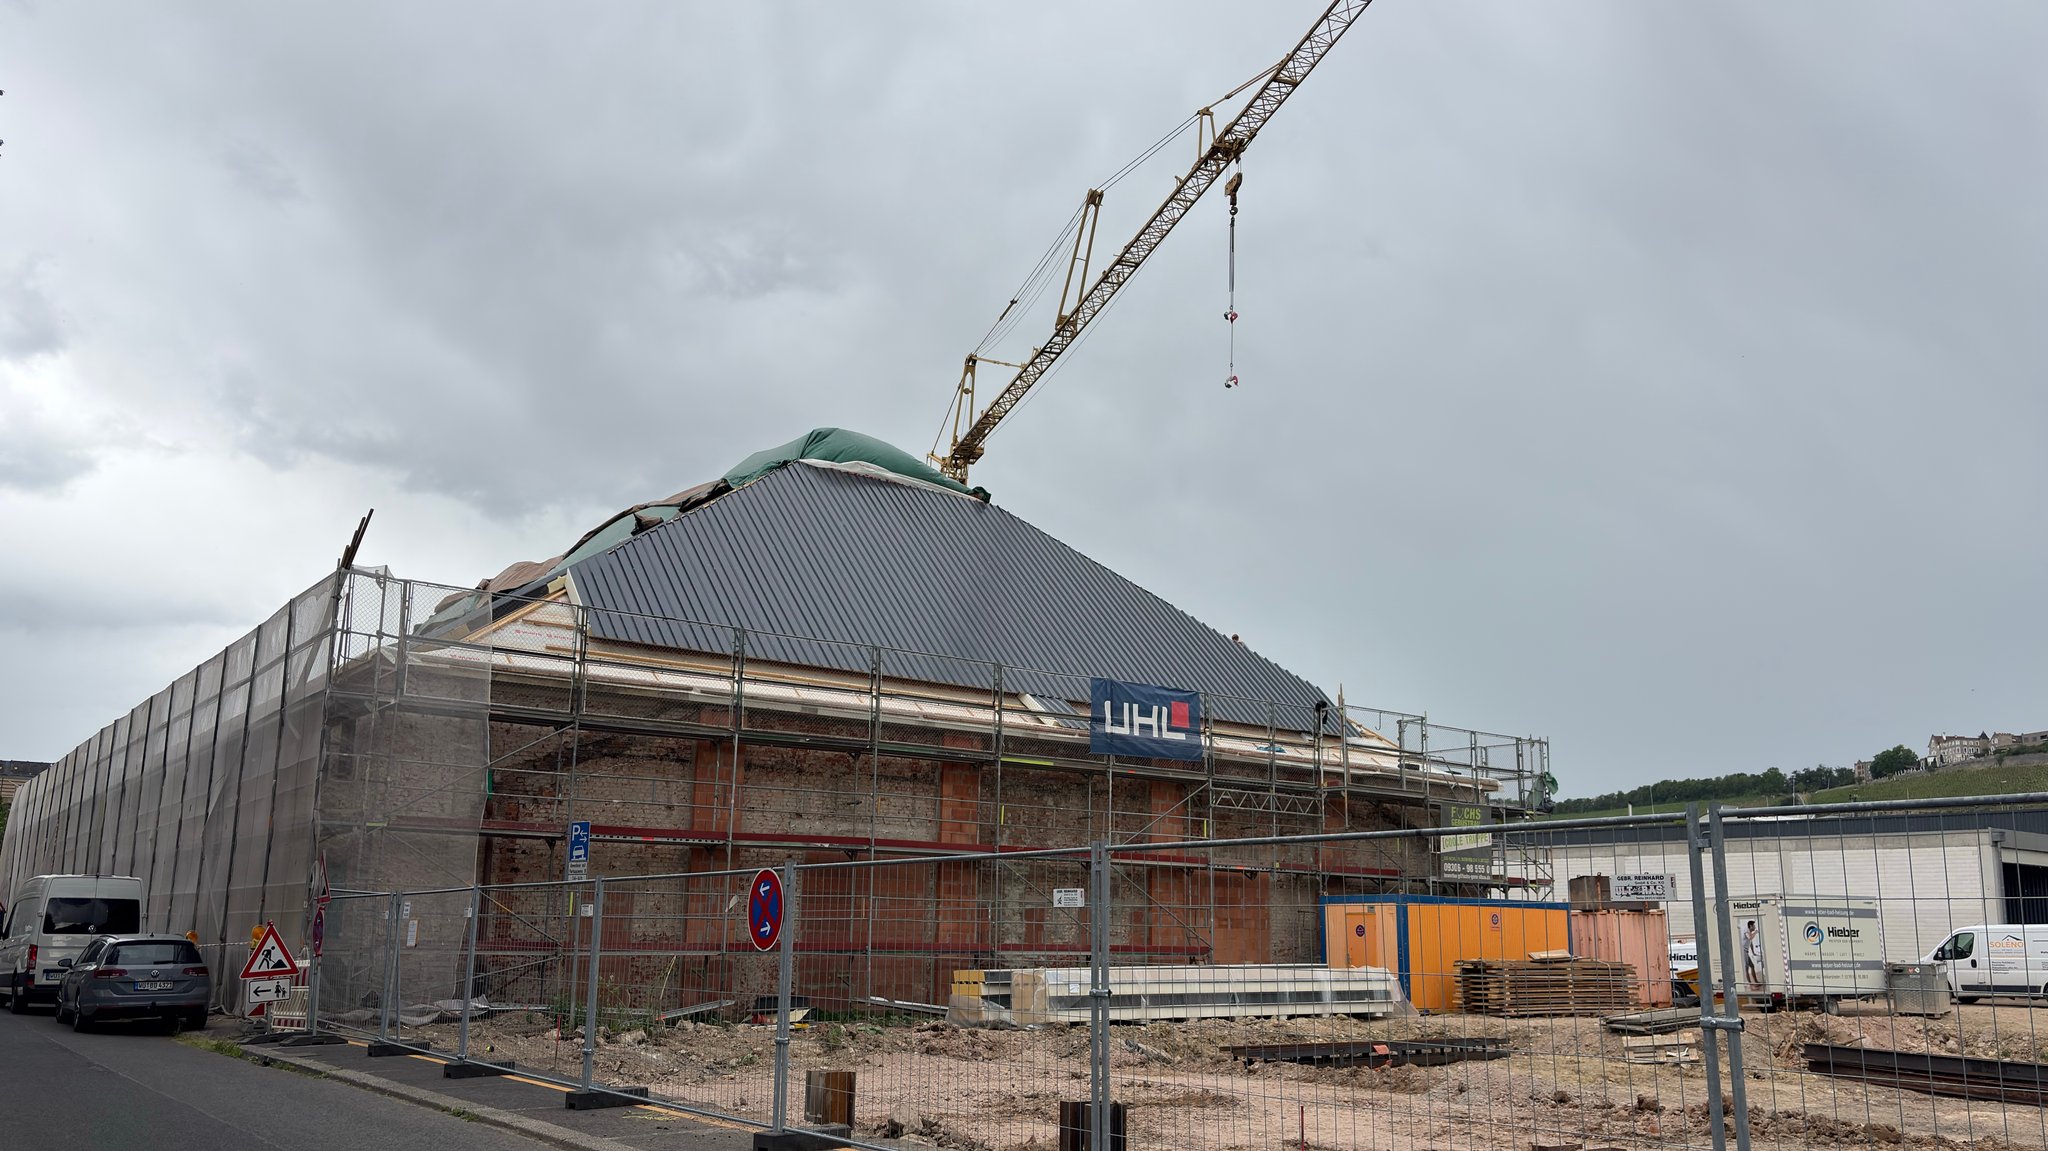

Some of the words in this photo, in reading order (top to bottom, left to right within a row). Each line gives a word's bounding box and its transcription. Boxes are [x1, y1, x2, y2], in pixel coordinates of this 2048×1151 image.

[1104, 700, 1186, 740] UHL
[1451, 806, 1481, 820] FUCHS
[572, 825, 580, 841] P
[1828, 926, 1860, 938] Hieber
